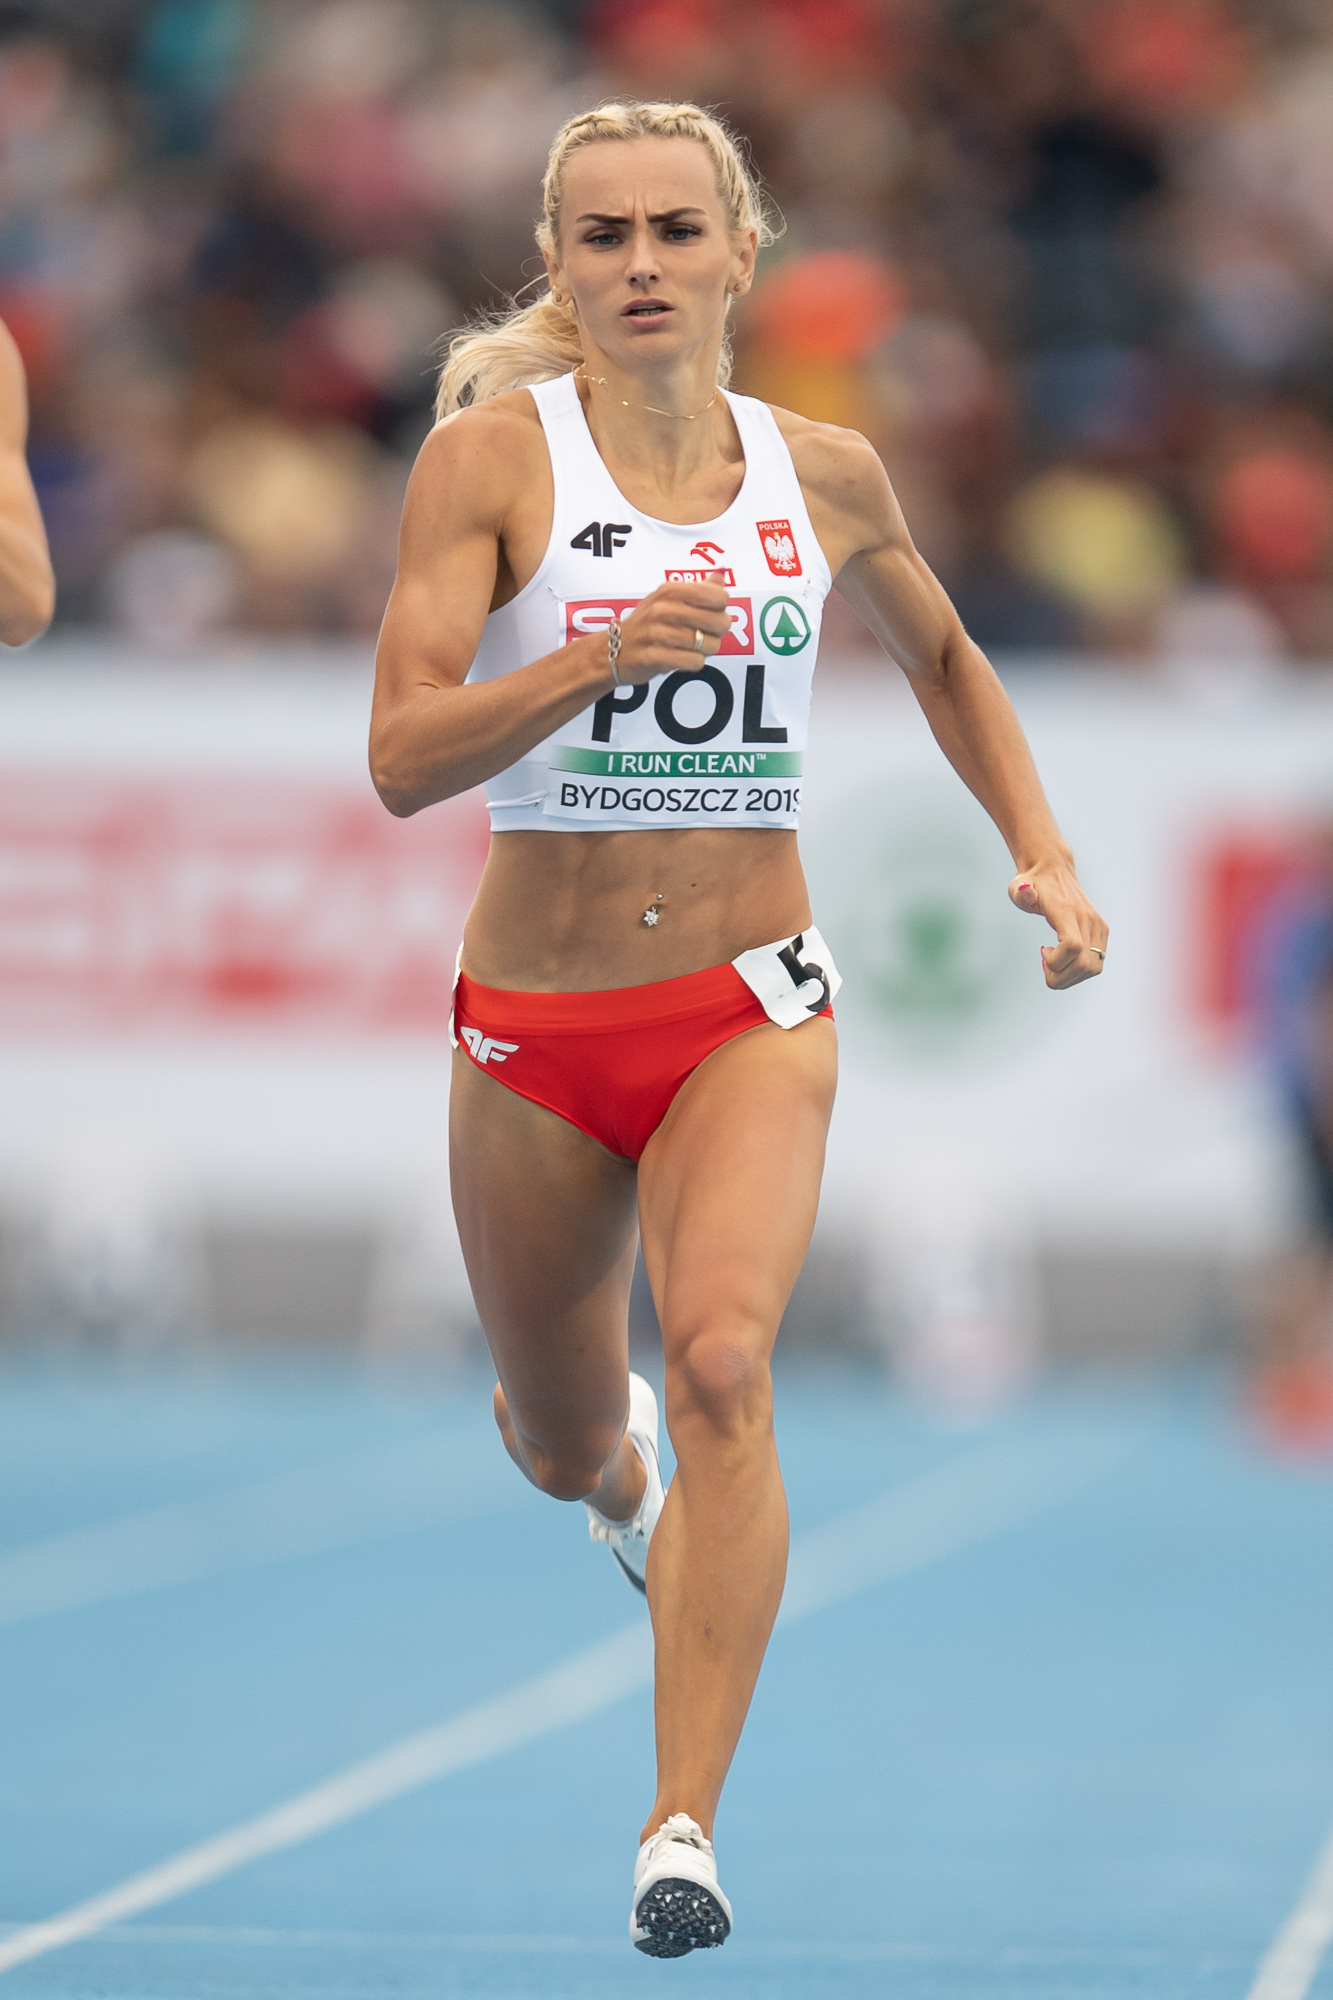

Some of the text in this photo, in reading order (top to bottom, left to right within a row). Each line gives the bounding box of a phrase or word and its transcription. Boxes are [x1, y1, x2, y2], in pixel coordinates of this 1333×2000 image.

[570, 521, 632, 558] 4F
[759, 522, 789, 531] POLSKA
[668, 571, 732, 585] ORLN
[572, 605, 750, 647] SR
[591, 664, 788, 744] POL
[607, 754, 615, 772] I
[621, 754, 671, 774] RUN
[560, 783, 739, 812] BYDGOSZCZ
[777, 932, 831, 1013] 5
